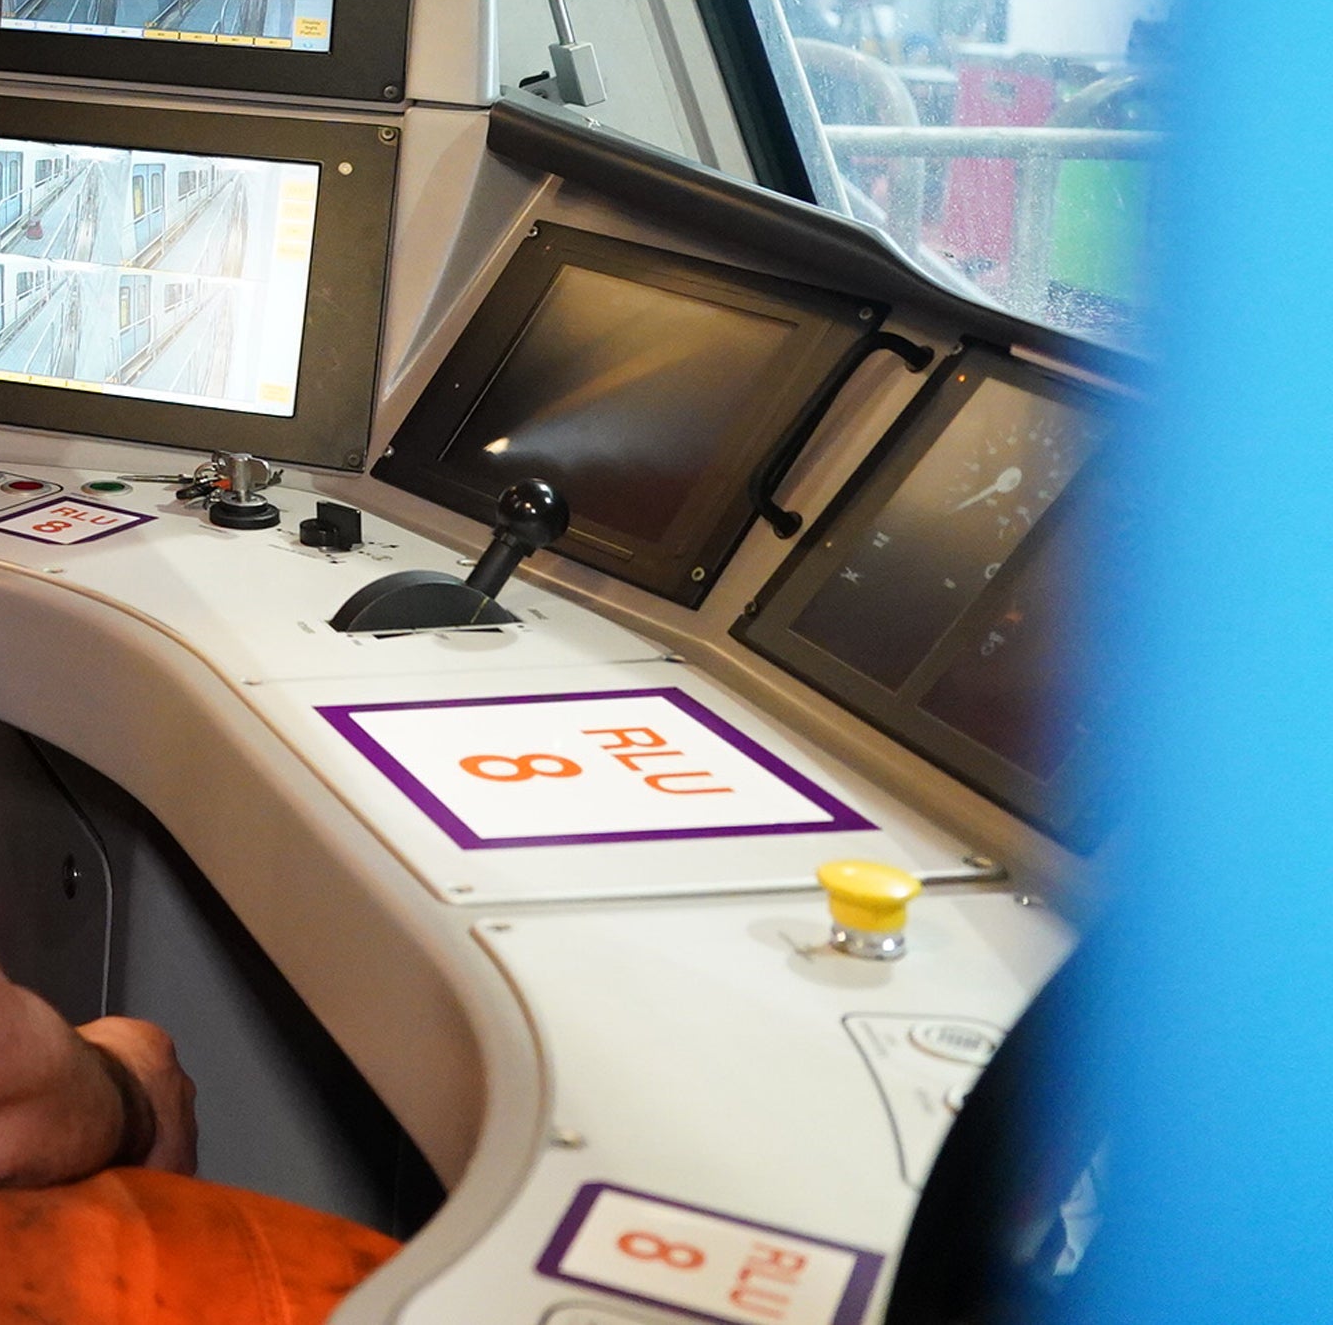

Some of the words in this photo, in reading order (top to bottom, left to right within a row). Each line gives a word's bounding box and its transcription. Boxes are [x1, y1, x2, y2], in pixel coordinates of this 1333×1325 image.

[32, 520, 73, 534] 8
[49, 506, 120, 526] RLU
[458, 753, 583, 782] 8
[580, 727, 735, 795] RLU
[614, 1230, 707, 1271] 8
[727, 1241, 809, 1321] RLU
